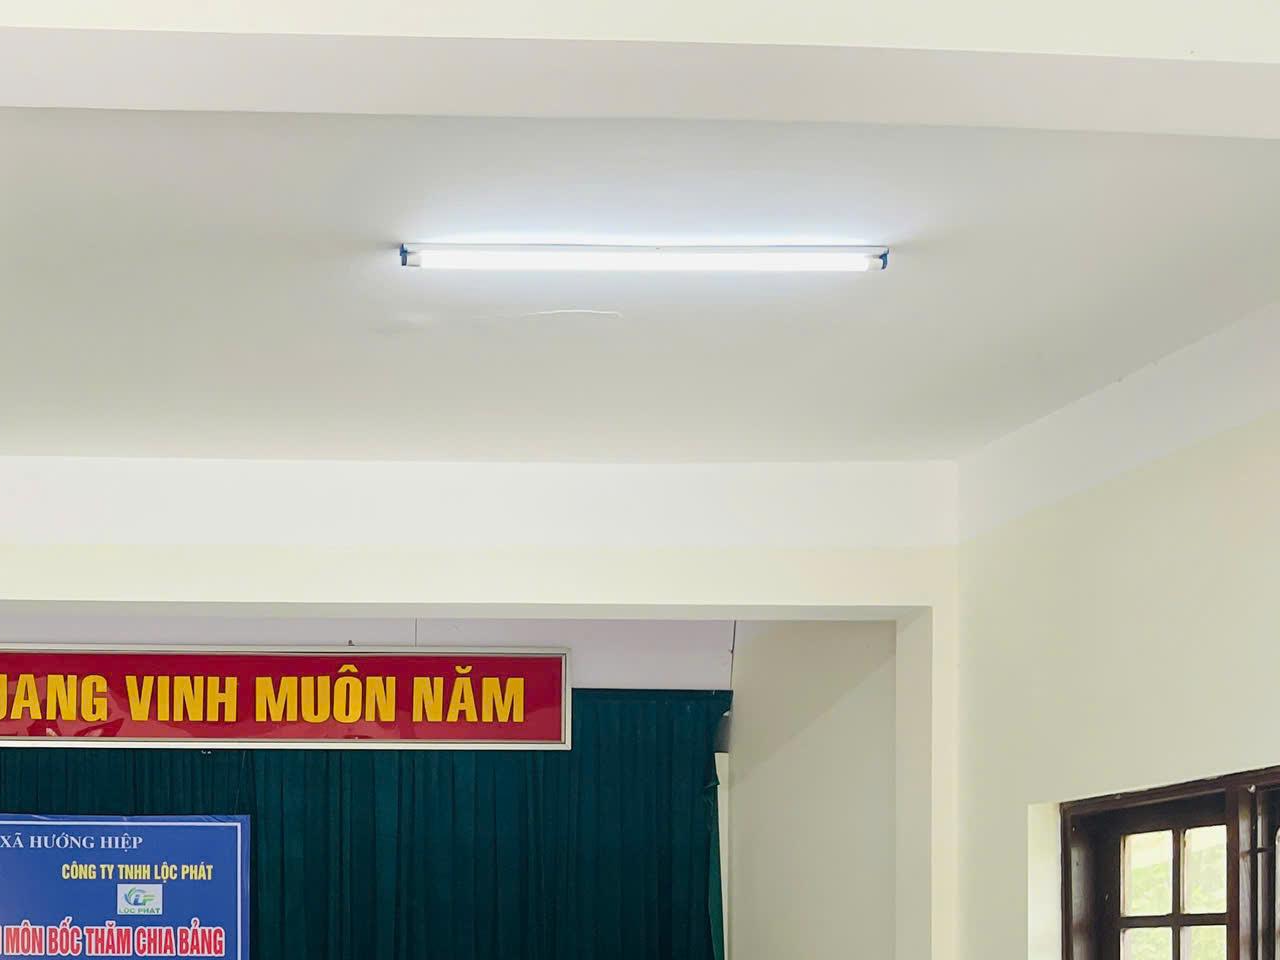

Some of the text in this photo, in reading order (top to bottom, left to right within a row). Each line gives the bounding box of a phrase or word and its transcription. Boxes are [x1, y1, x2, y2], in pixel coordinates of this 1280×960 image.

[125, 675, 238, 723] VINH
[255, 664, 395, 723] MUÔN
[412, 665, 524, 723] NĂM
[0, 832, 24, 848] XÃ
[29, 832, 95, 849] HƯỚNG
[100, 833, 143, 852] HIỆP
[61, 861, 213, 883] CÔNG TY TNHH LỘC PHÁT
[4, 919, 46, 955] MÔN
[47, 916, 81, 956] BỐC
[84, 920, 132, 956] THĂM
[135, 926, 174, 956] CHIA
[177, 917, 225, 956] BẢNG
